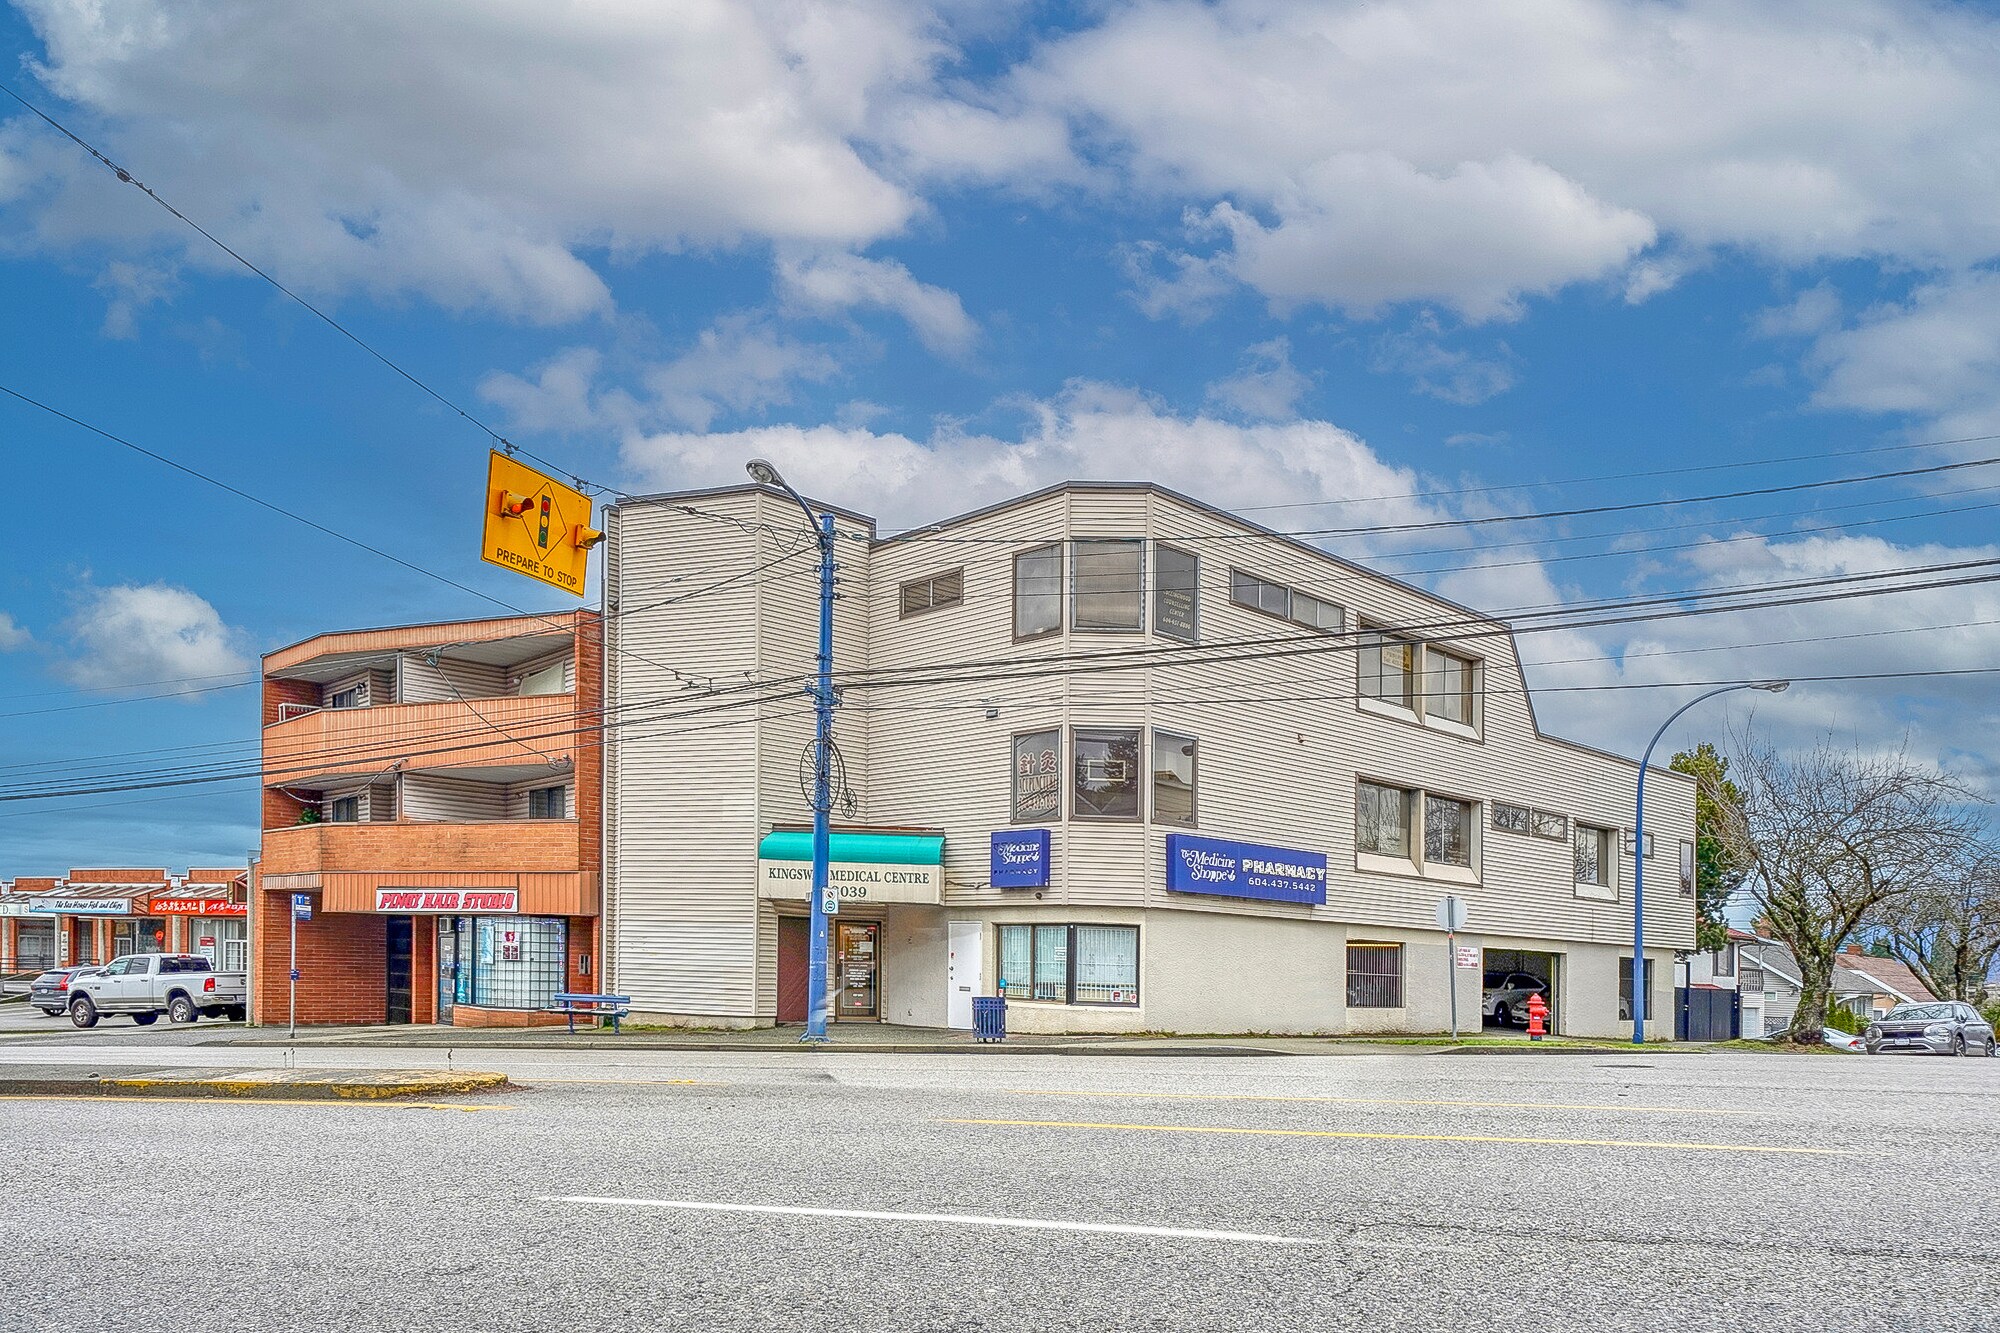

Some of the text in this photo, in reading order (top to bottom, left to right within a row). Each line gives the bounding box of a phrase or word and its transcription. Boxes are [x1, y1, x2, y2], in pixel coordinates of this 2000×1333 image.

[496, 547, 578, 588] PREPARE TO STOP
[1019, 749, 1057, 775] 針灸
[1186, 850, 1236, 869] Medicine
[768, 867, 930, 885] KINGSW MEDICAL CENTRE
[1190, 864, 1228, 883] Shoppe
[1242, 858, 1326, 881] PHARMACY
[1248, 876, 1316, 892] 604.437.5442
[88, 900, 99, 910] Fish
[98, 900, 109, 909] and
[108, 900, 124, 911] Chips
[421, 892, 460, 909] HAIR
[461, 892, 515, 909] STUDIO
